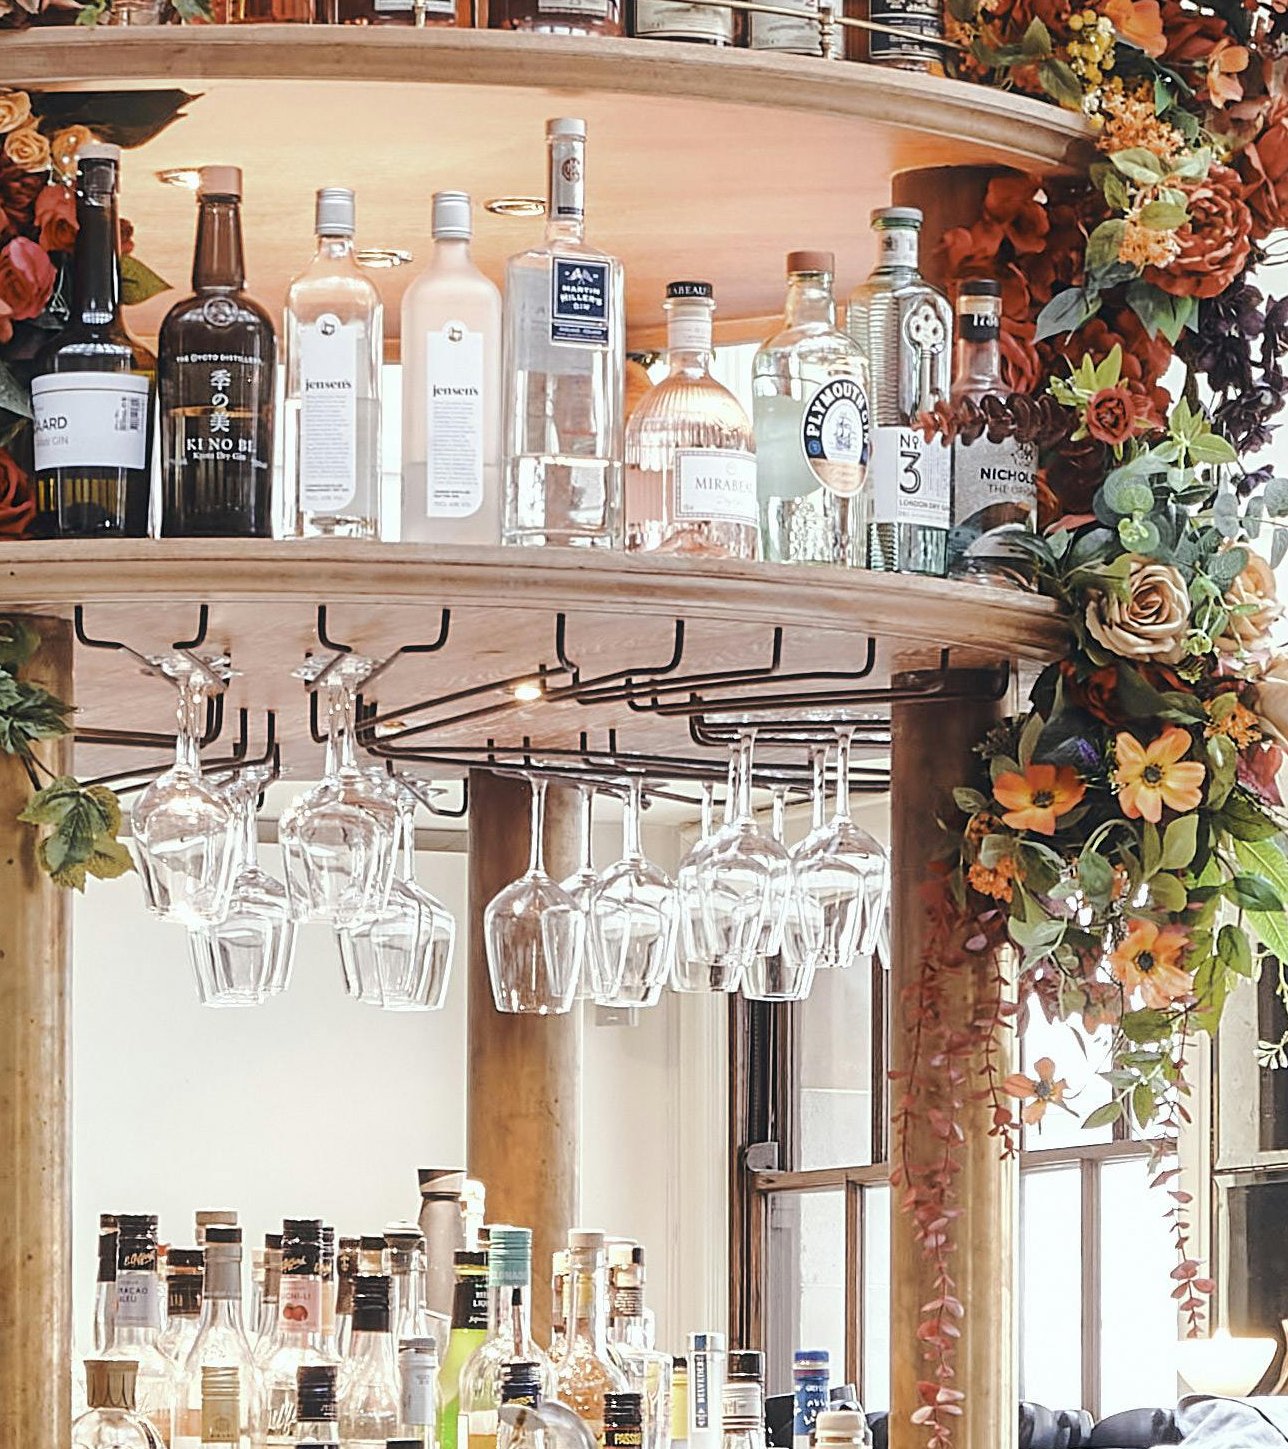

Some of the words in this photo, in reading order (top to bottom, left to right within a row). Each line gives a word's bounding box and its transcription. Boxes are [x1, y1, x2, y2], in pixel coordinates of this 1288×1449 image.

[561, 284, 601, 296] MARTIN
[673, 285, 707, 296] ABEAU
[572, 302, 592, 311] GIN
[304, 377, 353, 392] jensen's
[432, 383, 479, 398] jensen's
[209, 368, 232, 433] 季の美
[805, 382, 866, 438] PLYMOUTH
[34, 415, 68, 432] AARD
[51, 435, 69, 447] GIN
[186, 437, 203, 451] KI
[208, 437, 234, 451] NO
[237, 438, 252, 453] BI
[899, 450, 921, 495] 3
[980, 466, 1038, 485] NICHOLS
[899, 498, 928, 509] LONDON
[695, 1355, 707, 1404] BELVEDERE
